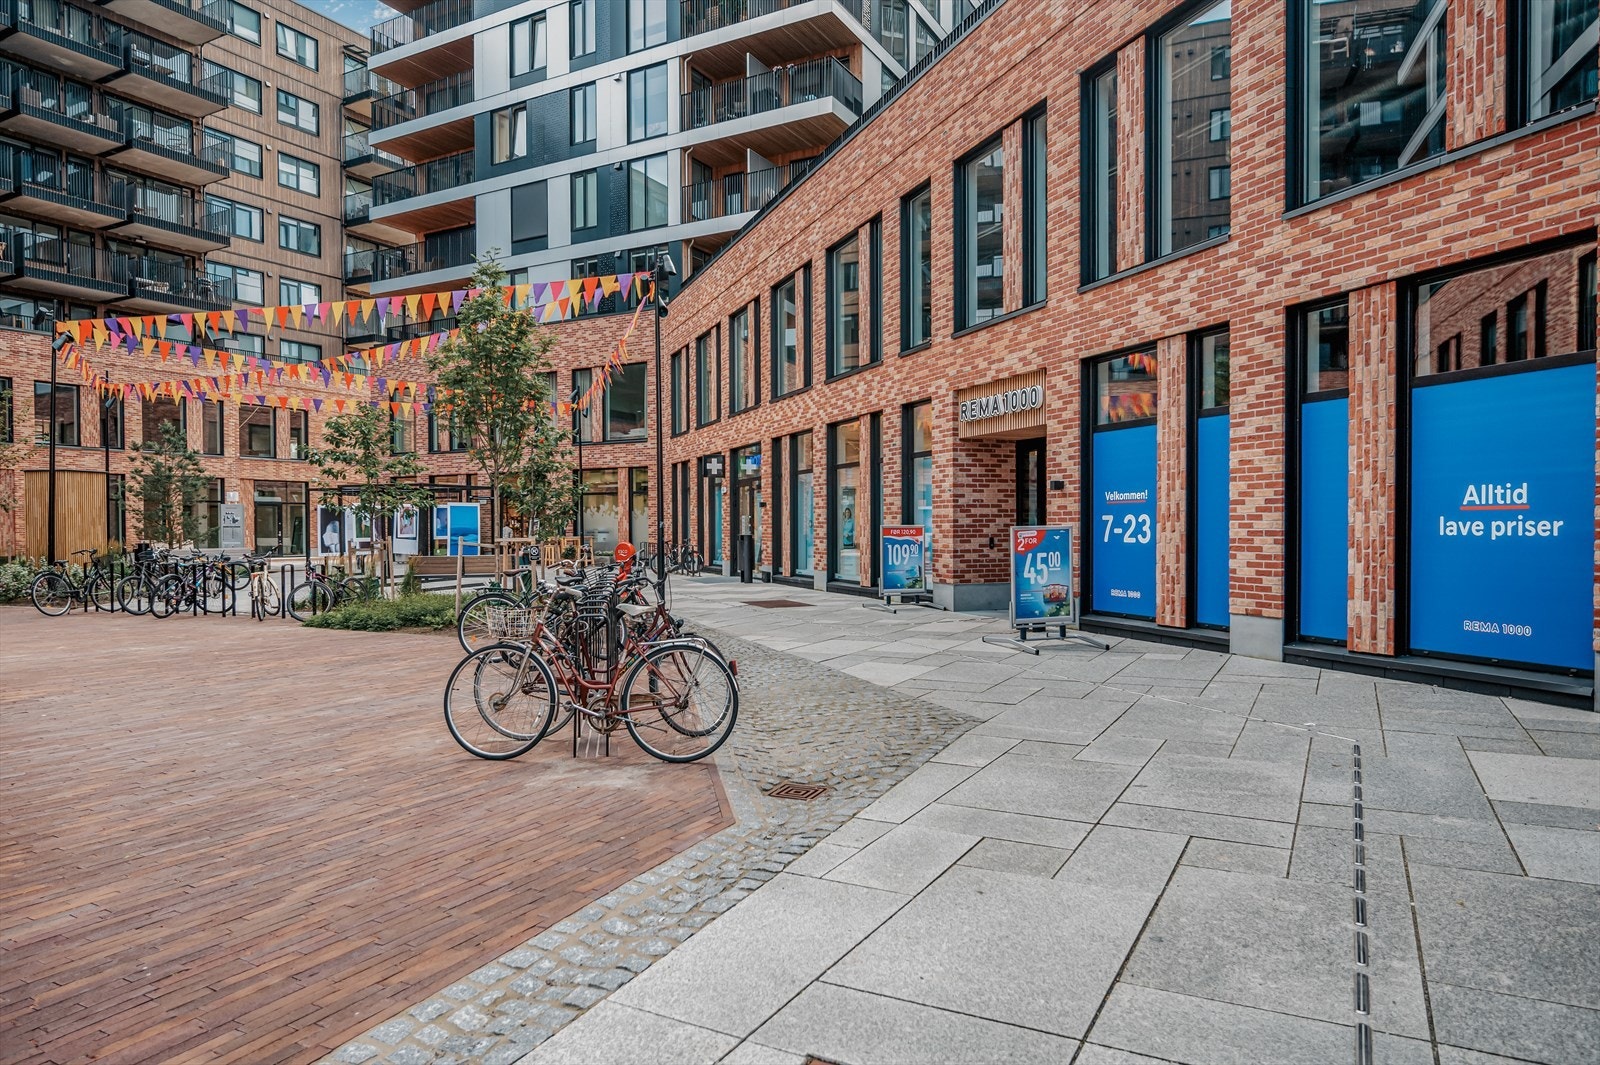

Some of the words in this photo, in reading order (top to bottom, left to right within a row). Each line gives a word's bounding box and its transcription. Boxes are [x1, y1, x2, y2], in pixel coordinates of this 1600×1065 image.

[960, 394, 1002, 422] REMA
[1003, 385, 1042, 413] 1000
[1105, 489, 1148, 501] Velkommen!
[1462, 482, 1528, 505] Alltid
[1101, 514, 1151, 544] 7-23
[1439, 516, 1484, 536] lave
[1491, 514, 1564, 540] priser
[887, 543, 910, 566] 109
[1017, 538, 1025, 551] 2
[1023, 552, 1049, 585] 45
[1463, 620, 1500, 634] REMA
[1502, 623, 1532, 637] 1000
